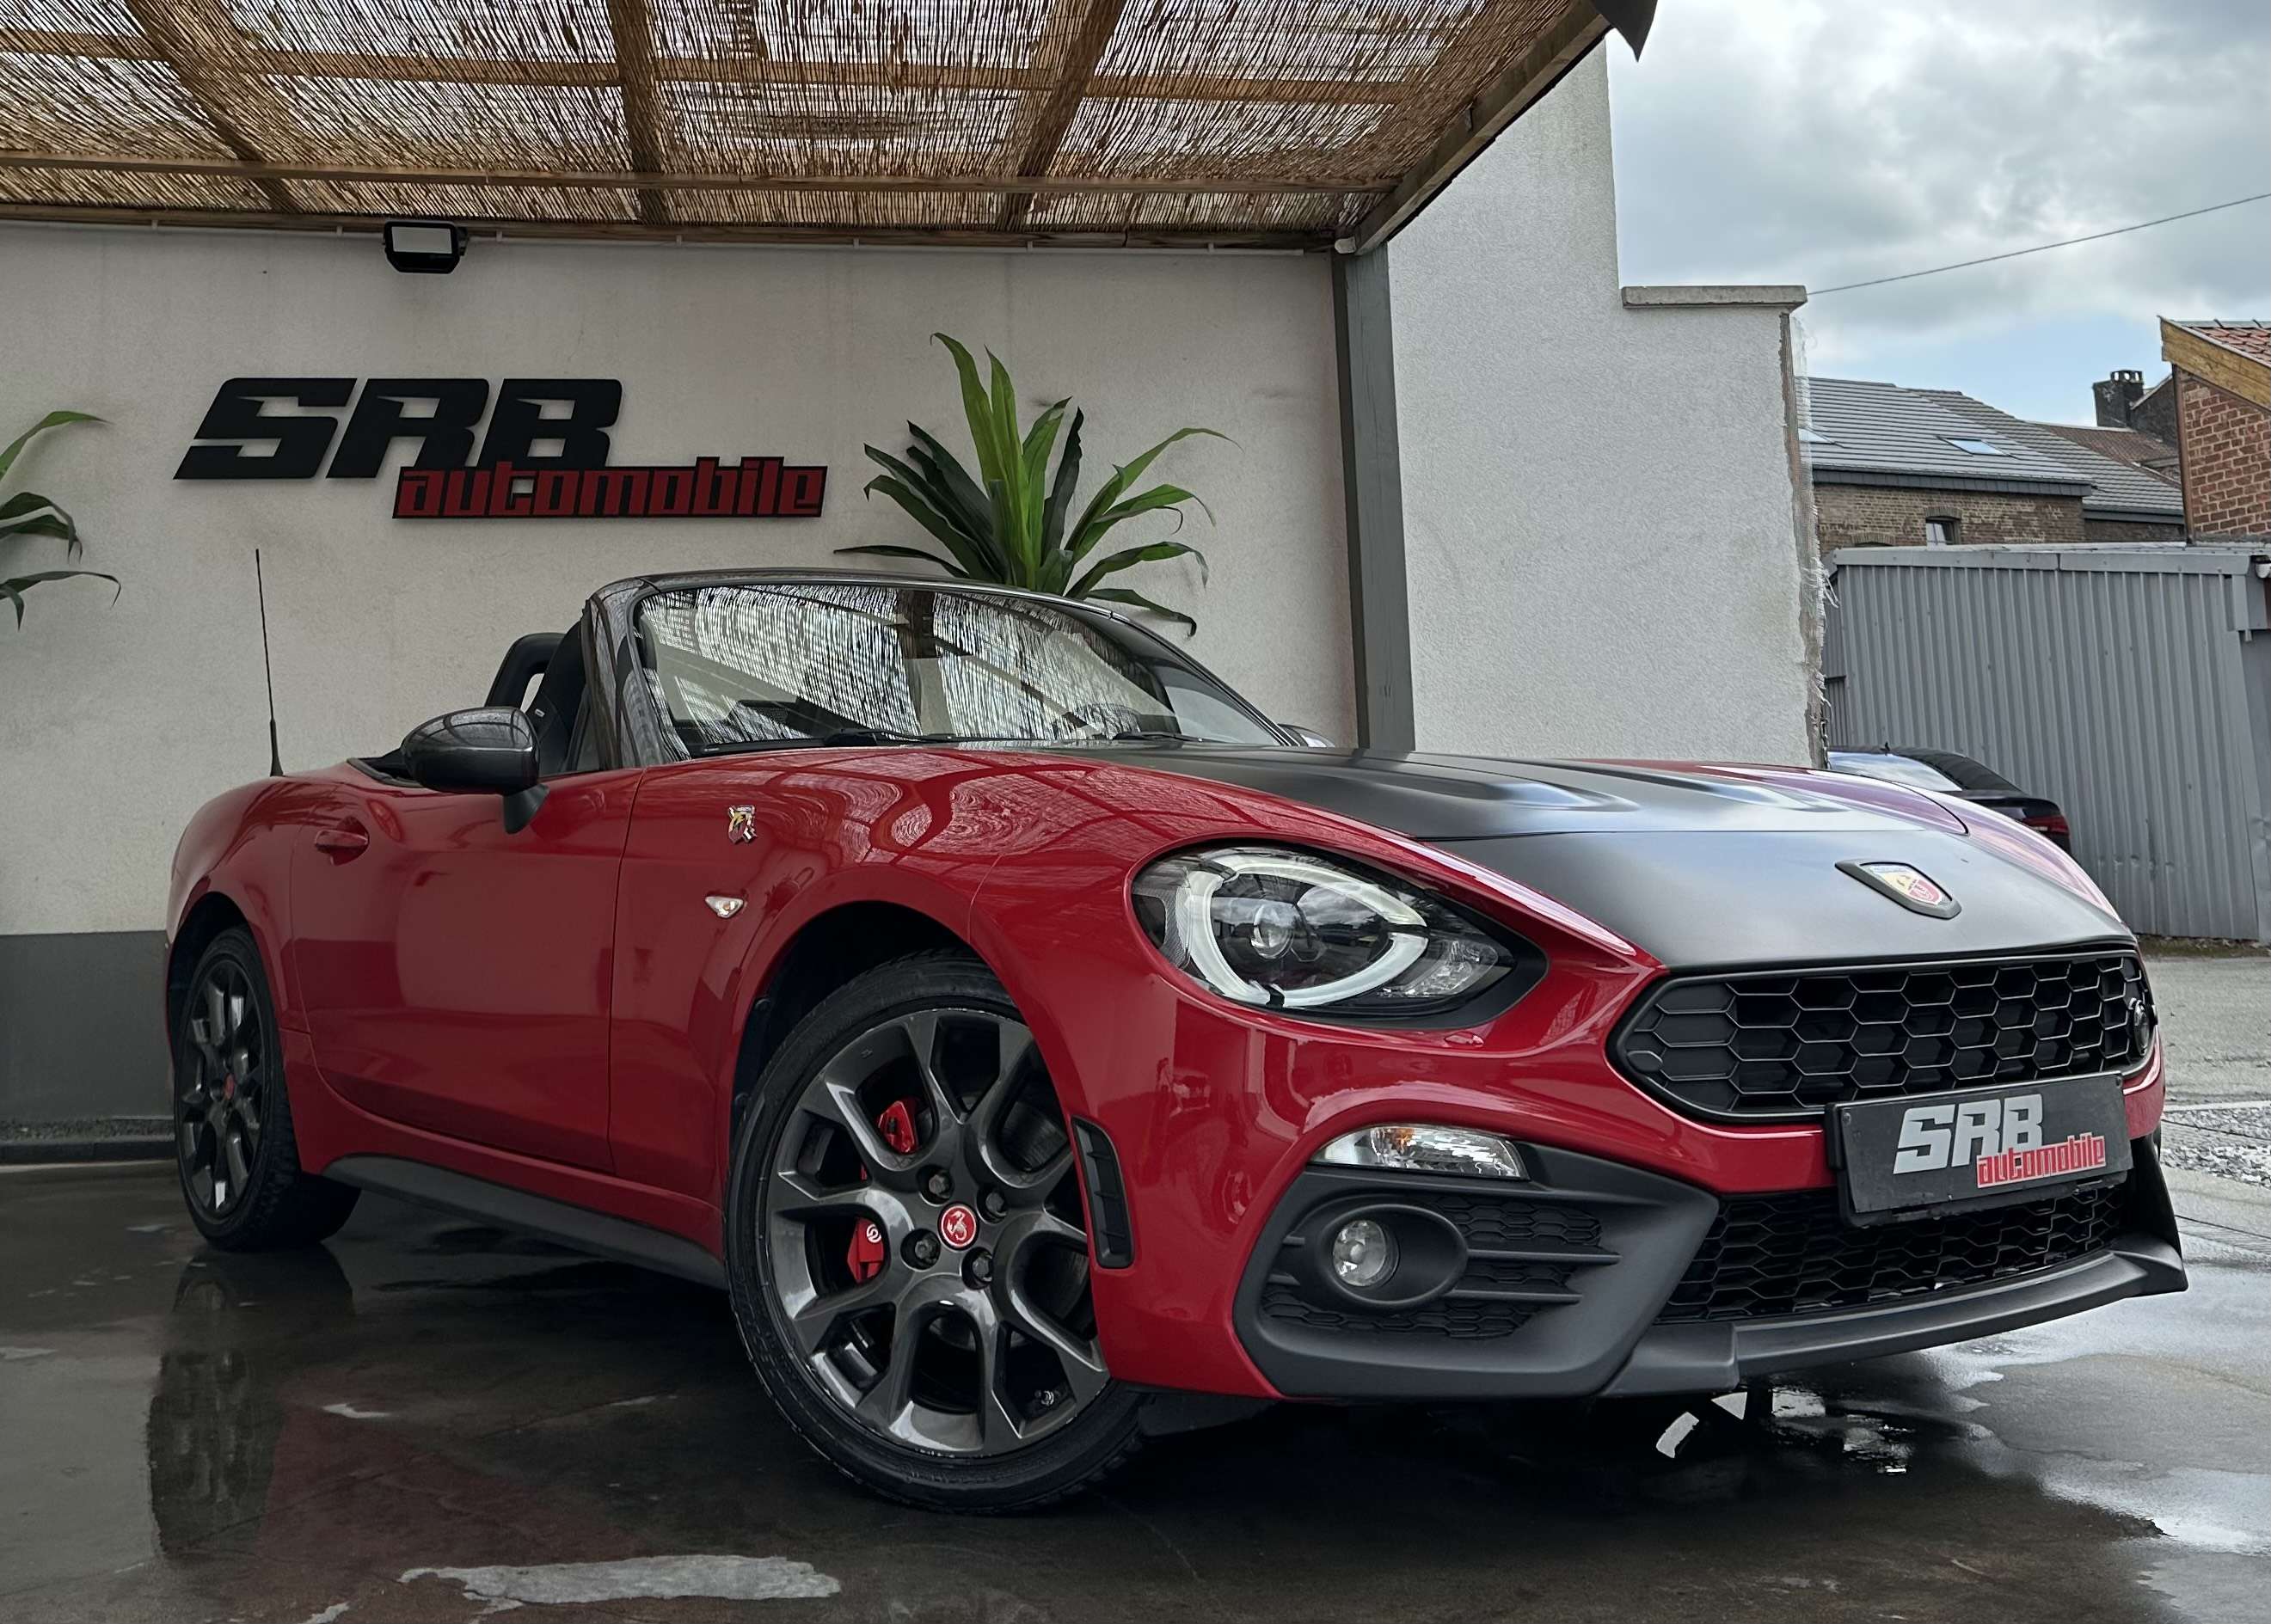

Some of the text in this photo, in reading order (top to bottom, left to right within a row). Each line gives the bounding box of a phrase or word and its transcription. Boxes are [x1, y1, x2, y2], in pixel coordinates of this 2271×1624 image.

[174, 378, 623, 479] SRB
[394, 457, 826, 519] automobile
[1893, 1094, 2044, 1174] SRB
[1977, 1132, 2106, 1189] automobile
